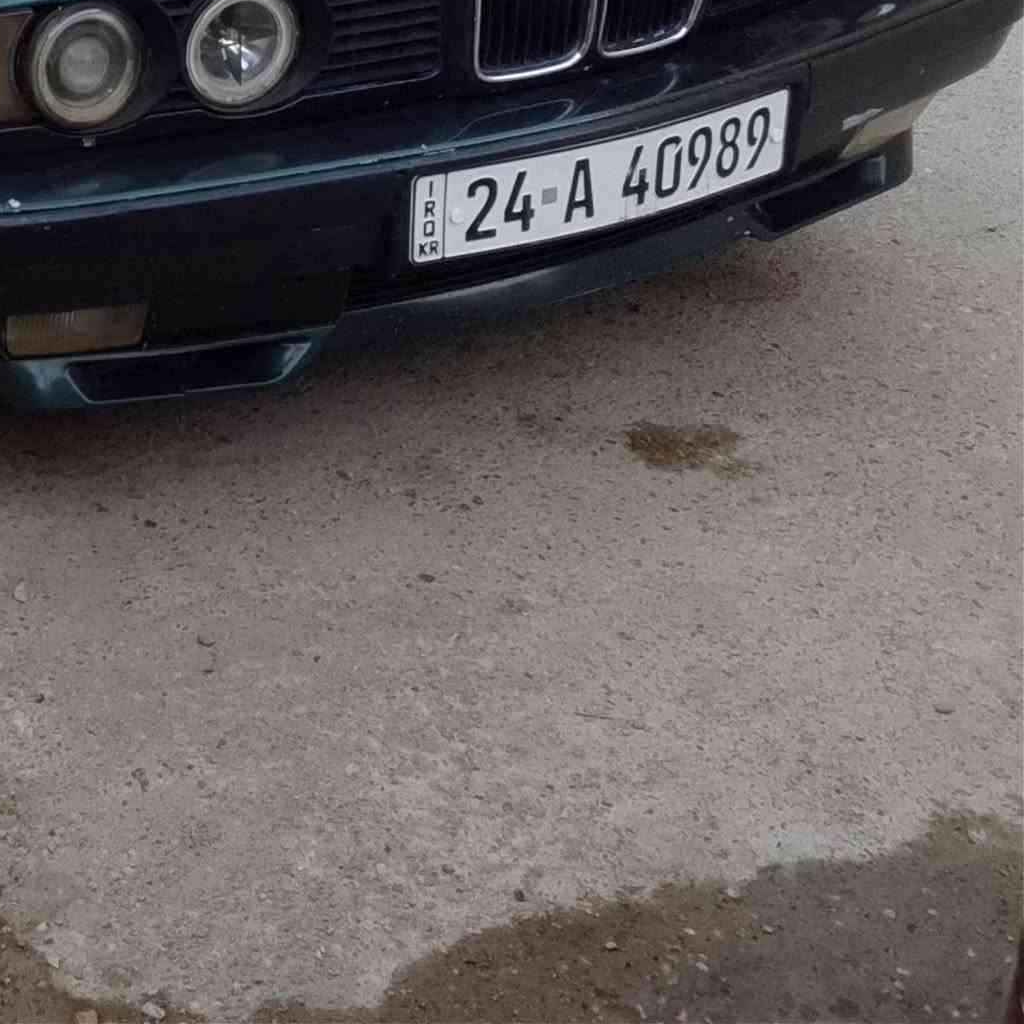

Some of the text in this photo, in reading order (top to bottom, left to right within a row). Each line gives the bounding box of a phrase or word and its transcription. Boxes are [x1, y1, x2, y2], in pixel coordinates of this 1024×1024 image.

[465, 107, 771, 242] 24 A 40989
[418, 240, 439, 256] KR
